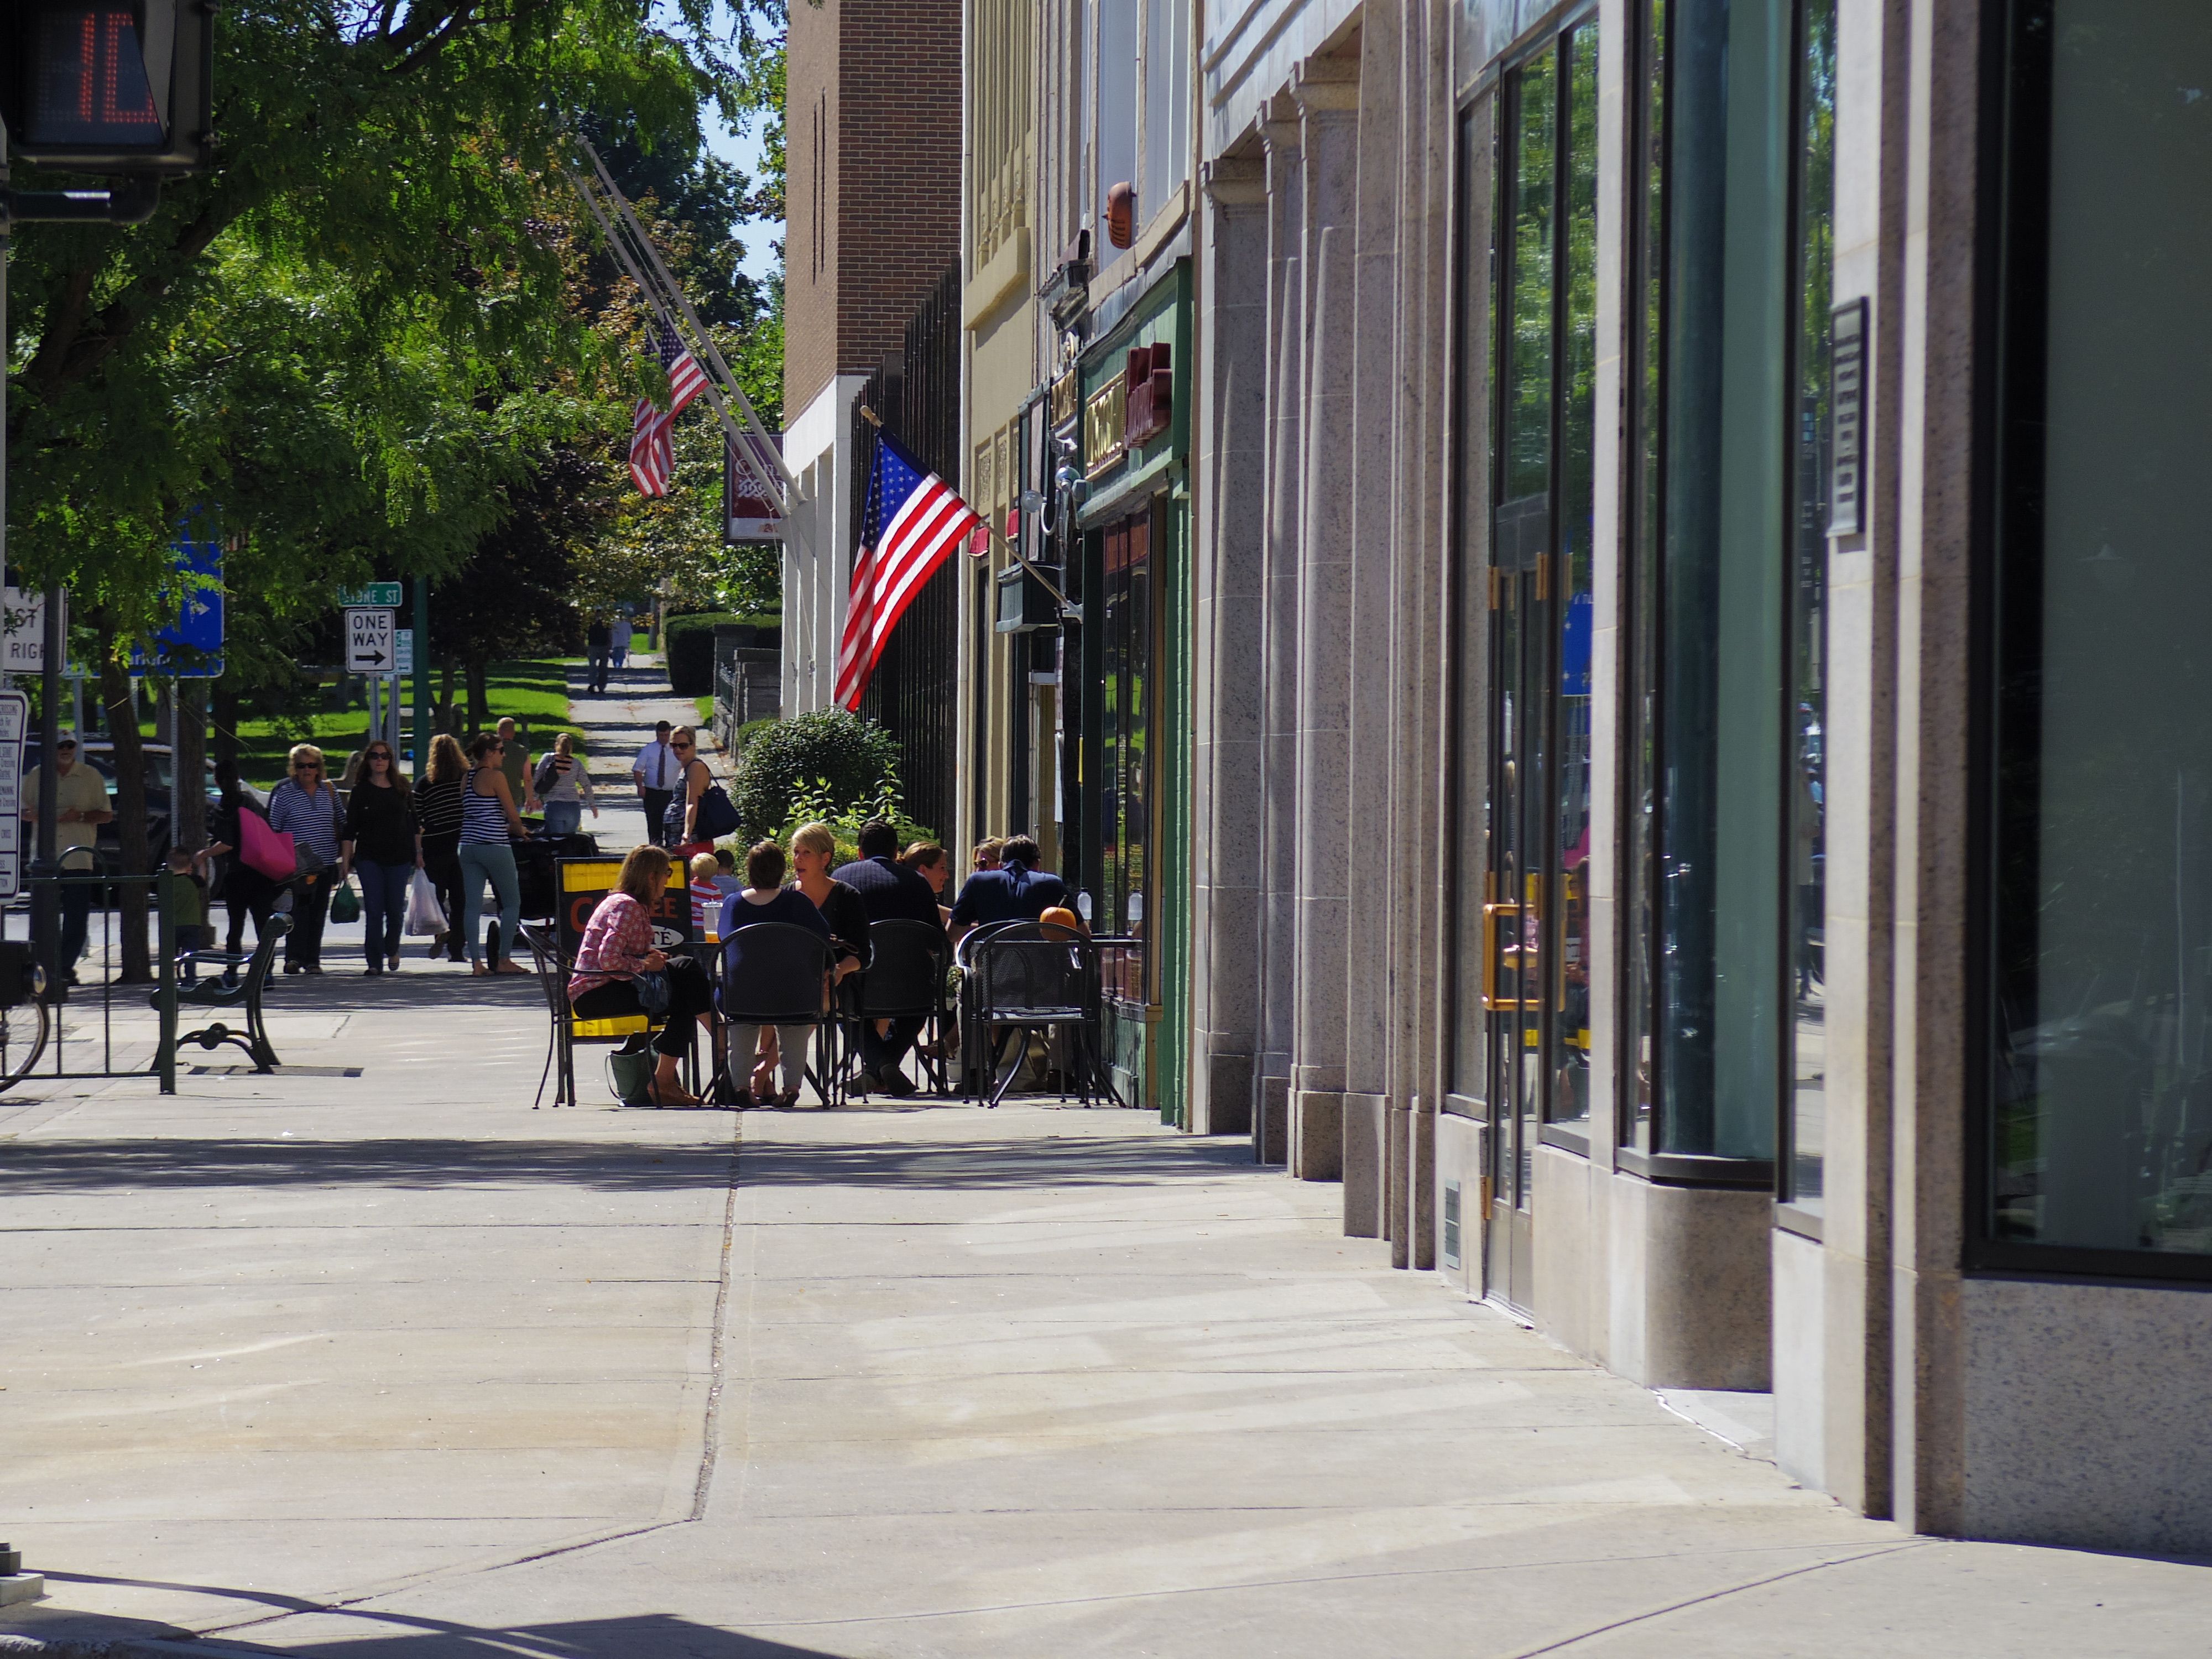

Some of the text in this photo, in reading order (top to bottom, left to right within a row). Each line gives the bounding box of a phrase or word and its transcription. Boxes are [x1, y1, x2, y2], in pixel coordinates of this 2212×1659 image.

[80, 12, 159, 123] 10
[386, 589, 398, 603] ST
[14, 608, 36, 628] ST
[353, 615, 387, 629] ONE
[352, 633, 388, 646] WAY
[11, 643, 44, 659] RIGH
[570, 897, 678, 933] CEE
[651, 928, 673, 945] TÉ
